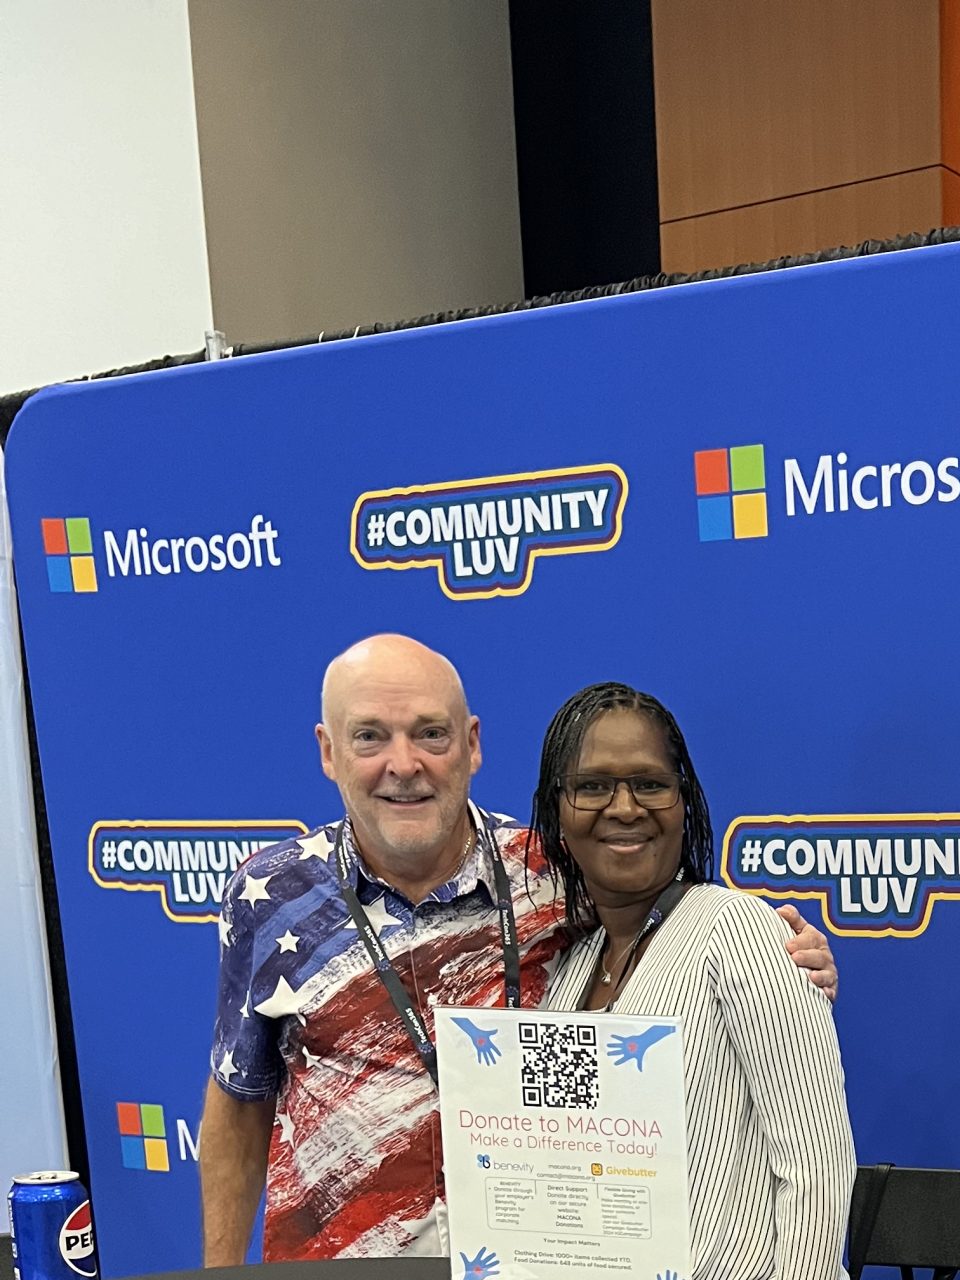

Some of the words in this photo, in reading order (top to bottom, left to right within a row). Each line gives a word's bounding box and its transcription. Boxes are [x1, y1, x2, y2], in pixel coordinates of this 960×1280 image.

[368, 490, 608, 547] #COMMUNITY
[104, 515, 281, 578] Microsoft
[454, 537, 521, 577] LUV
[173, 872, 226, 903] LUV
[841, 877, 917, 913] LUV
[459, 1110, 532, 1132] Donate
[539, 1116, 559, 1132] to
[567, 1116, 662, 1138] MACONA
[470, 1133, 508, 1147] Make
[513, 1138, 522, 1148] a
[528, 1136, 602, 1152] Difference
[607, 1140, 657, 1158] Today!
[494, 1161, 534, 1173] benevity
[606, 1167, 657, 1177] Givebutter
